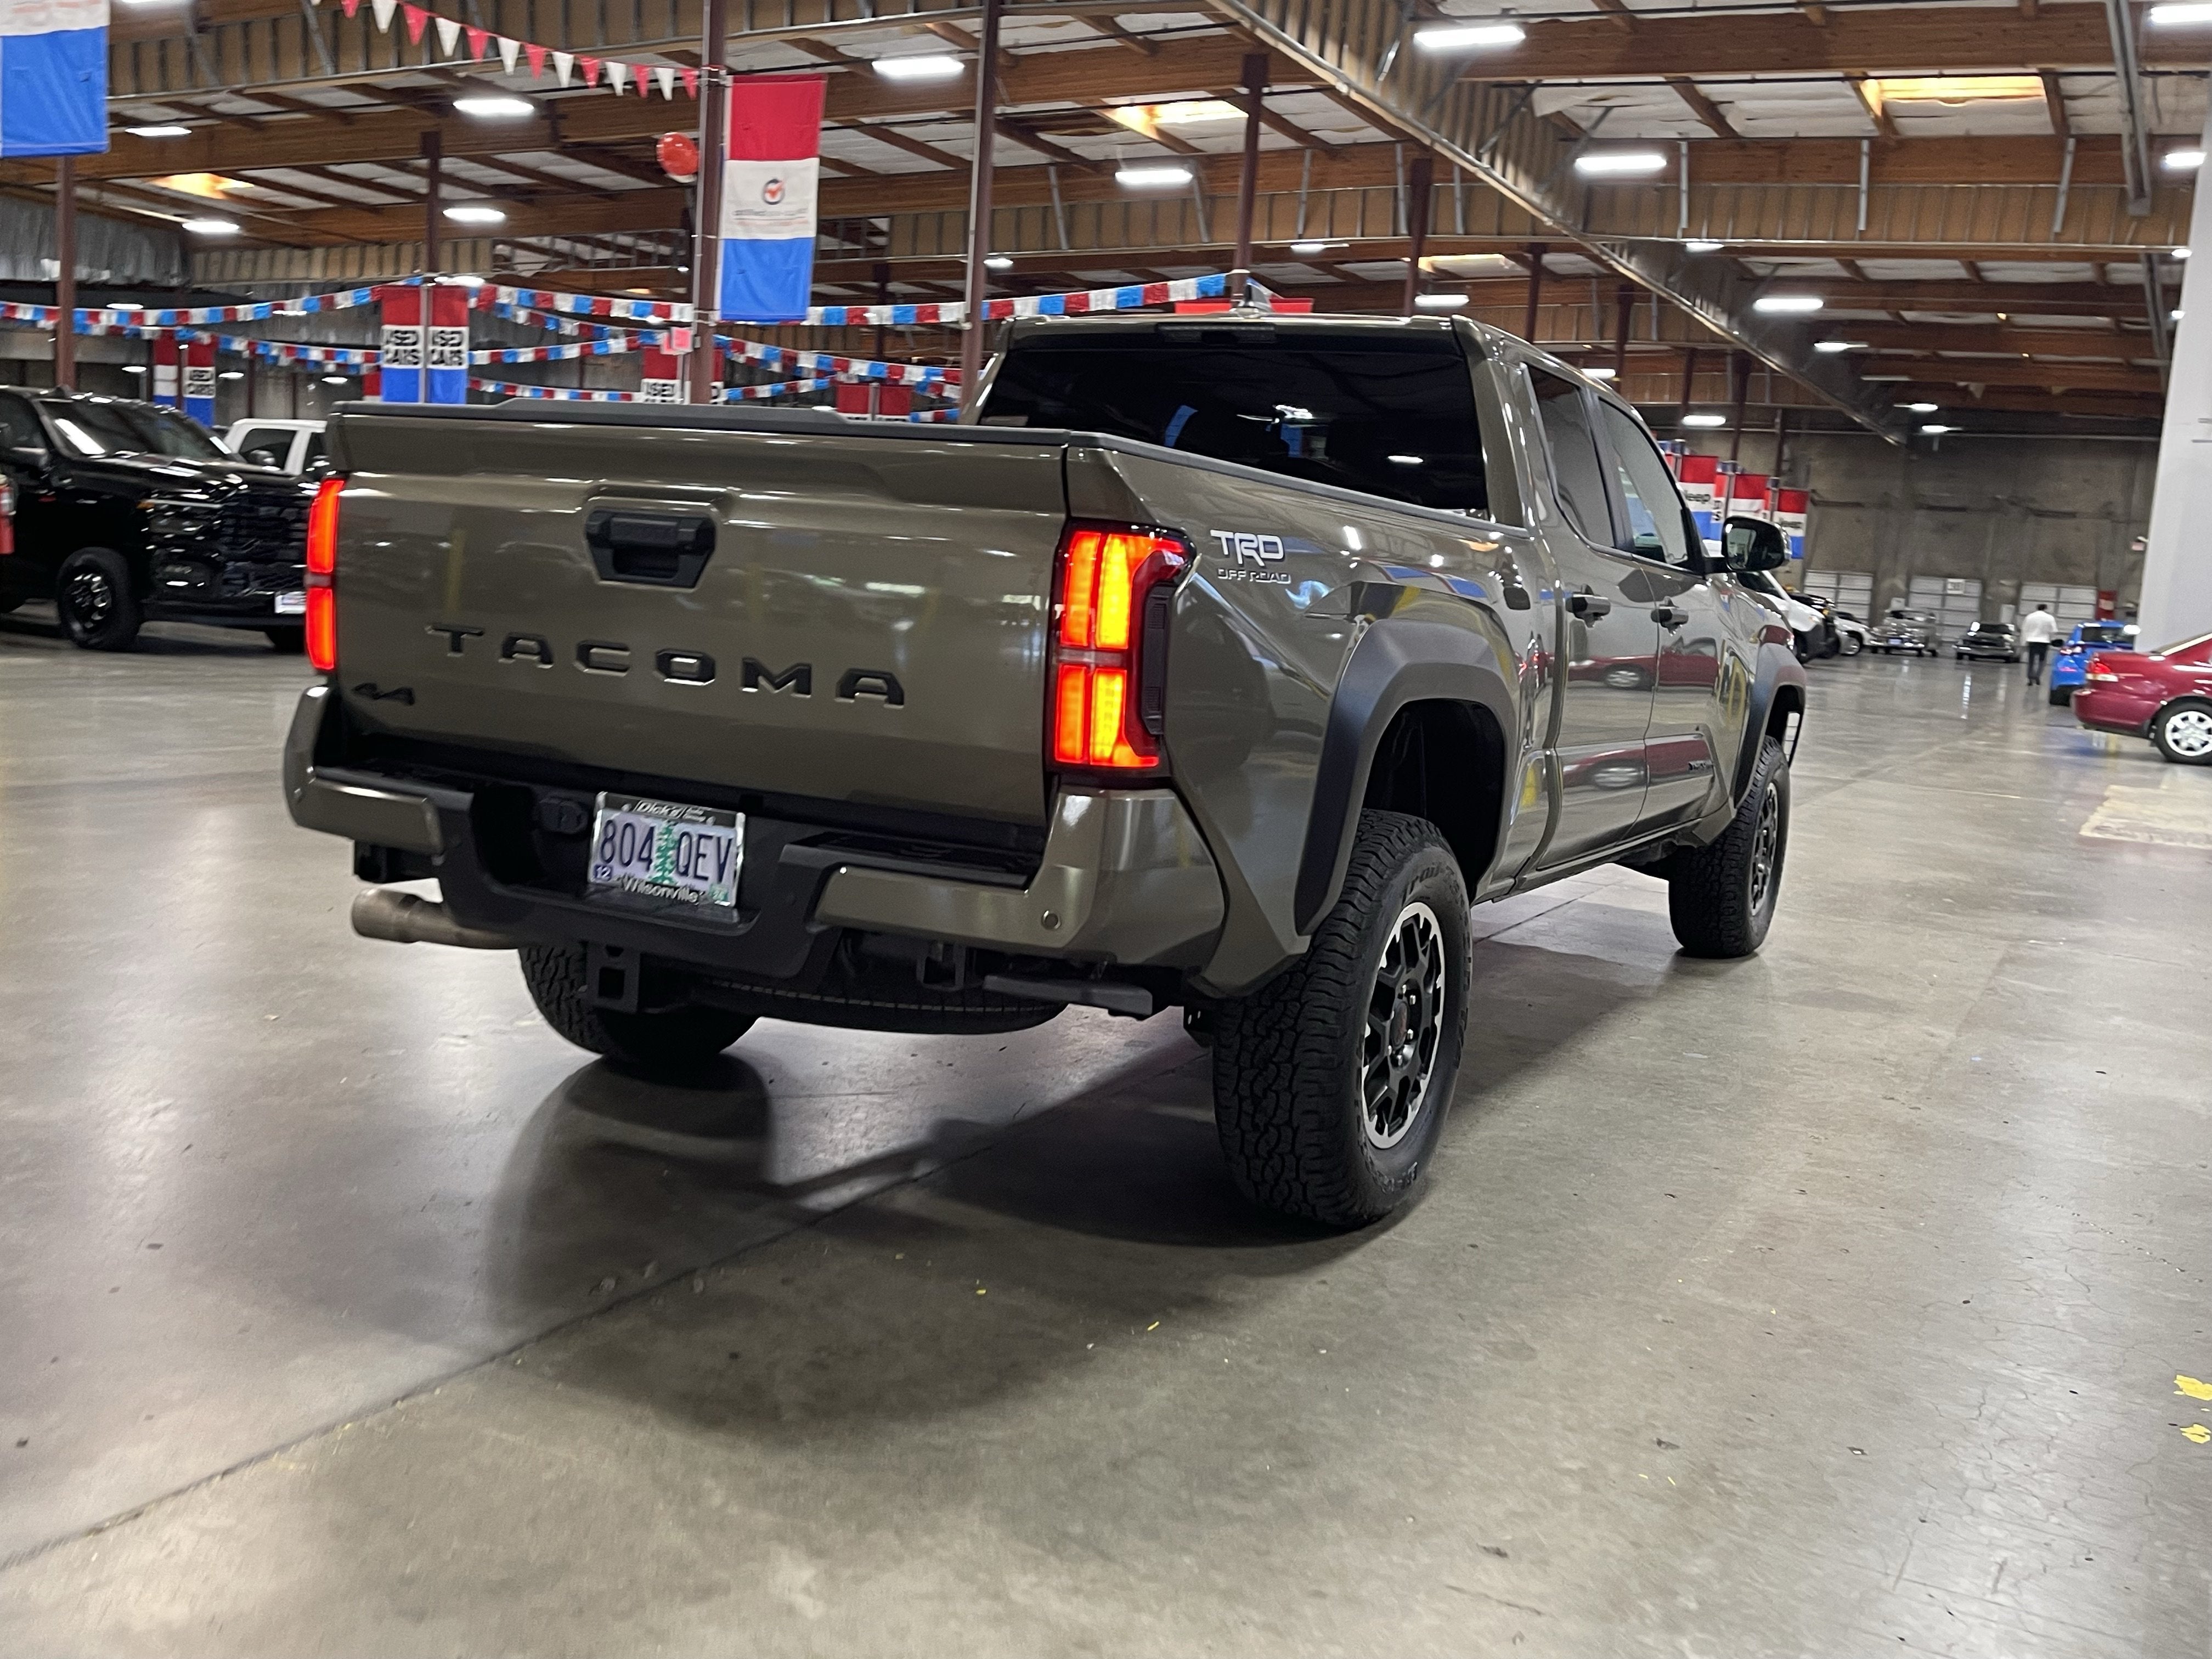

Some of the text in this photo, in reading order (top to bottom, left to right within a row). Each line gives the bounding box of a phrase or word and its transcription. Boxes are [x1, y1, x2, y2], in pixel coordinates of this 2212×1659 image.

[1210, 529, 1284, 566] TRD
[1217, 568, 1246, 581] OFF
[425, 623, 905, 708] TACOMA
[601, 819, 733, 884] 804 QEV
